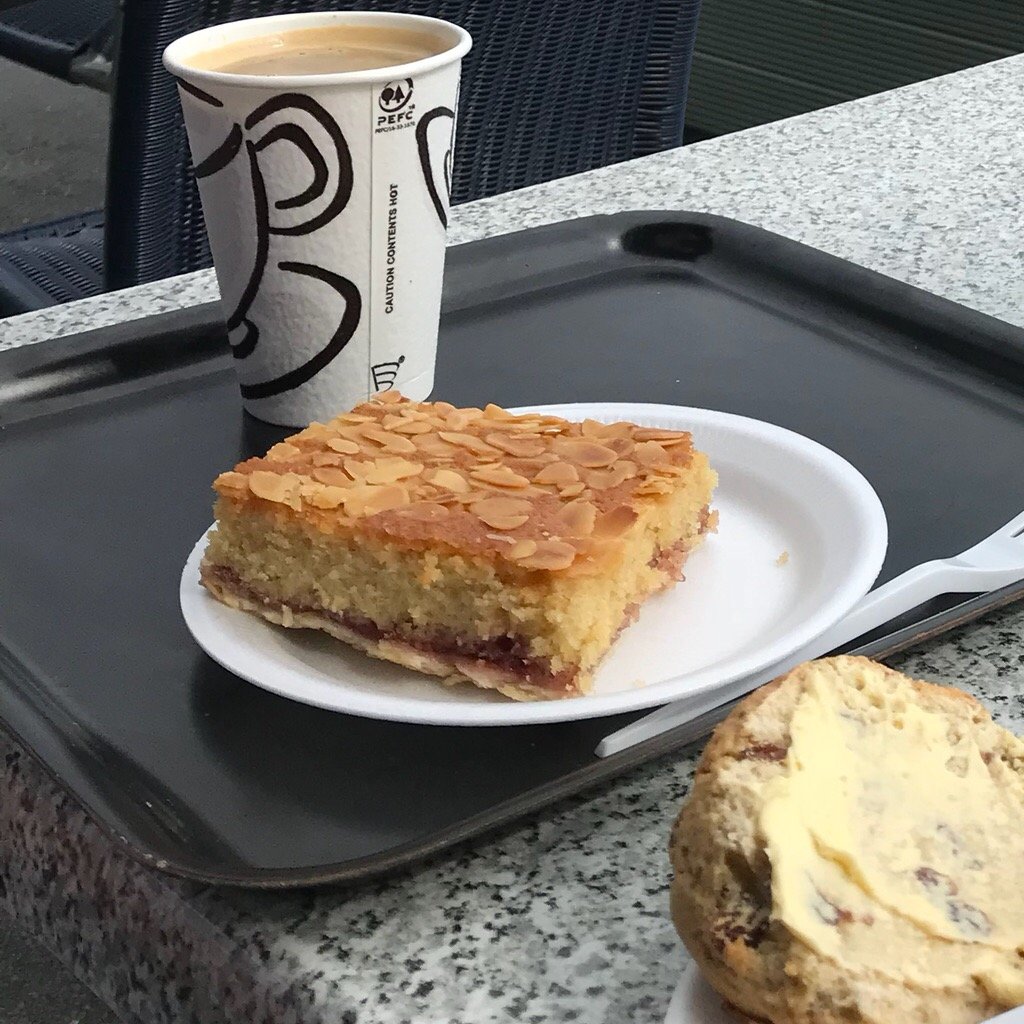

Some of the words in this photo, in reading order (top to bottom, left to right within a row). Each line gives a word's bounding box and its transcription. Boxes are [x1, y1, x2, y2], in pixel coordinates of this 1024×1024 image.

[377, 110, 414, 126] PEFC
[389, 183, 399, 207] HOT
[386, 207, 398, 265] CONTENTS
[384, 267, 395, 315] CAUTION
